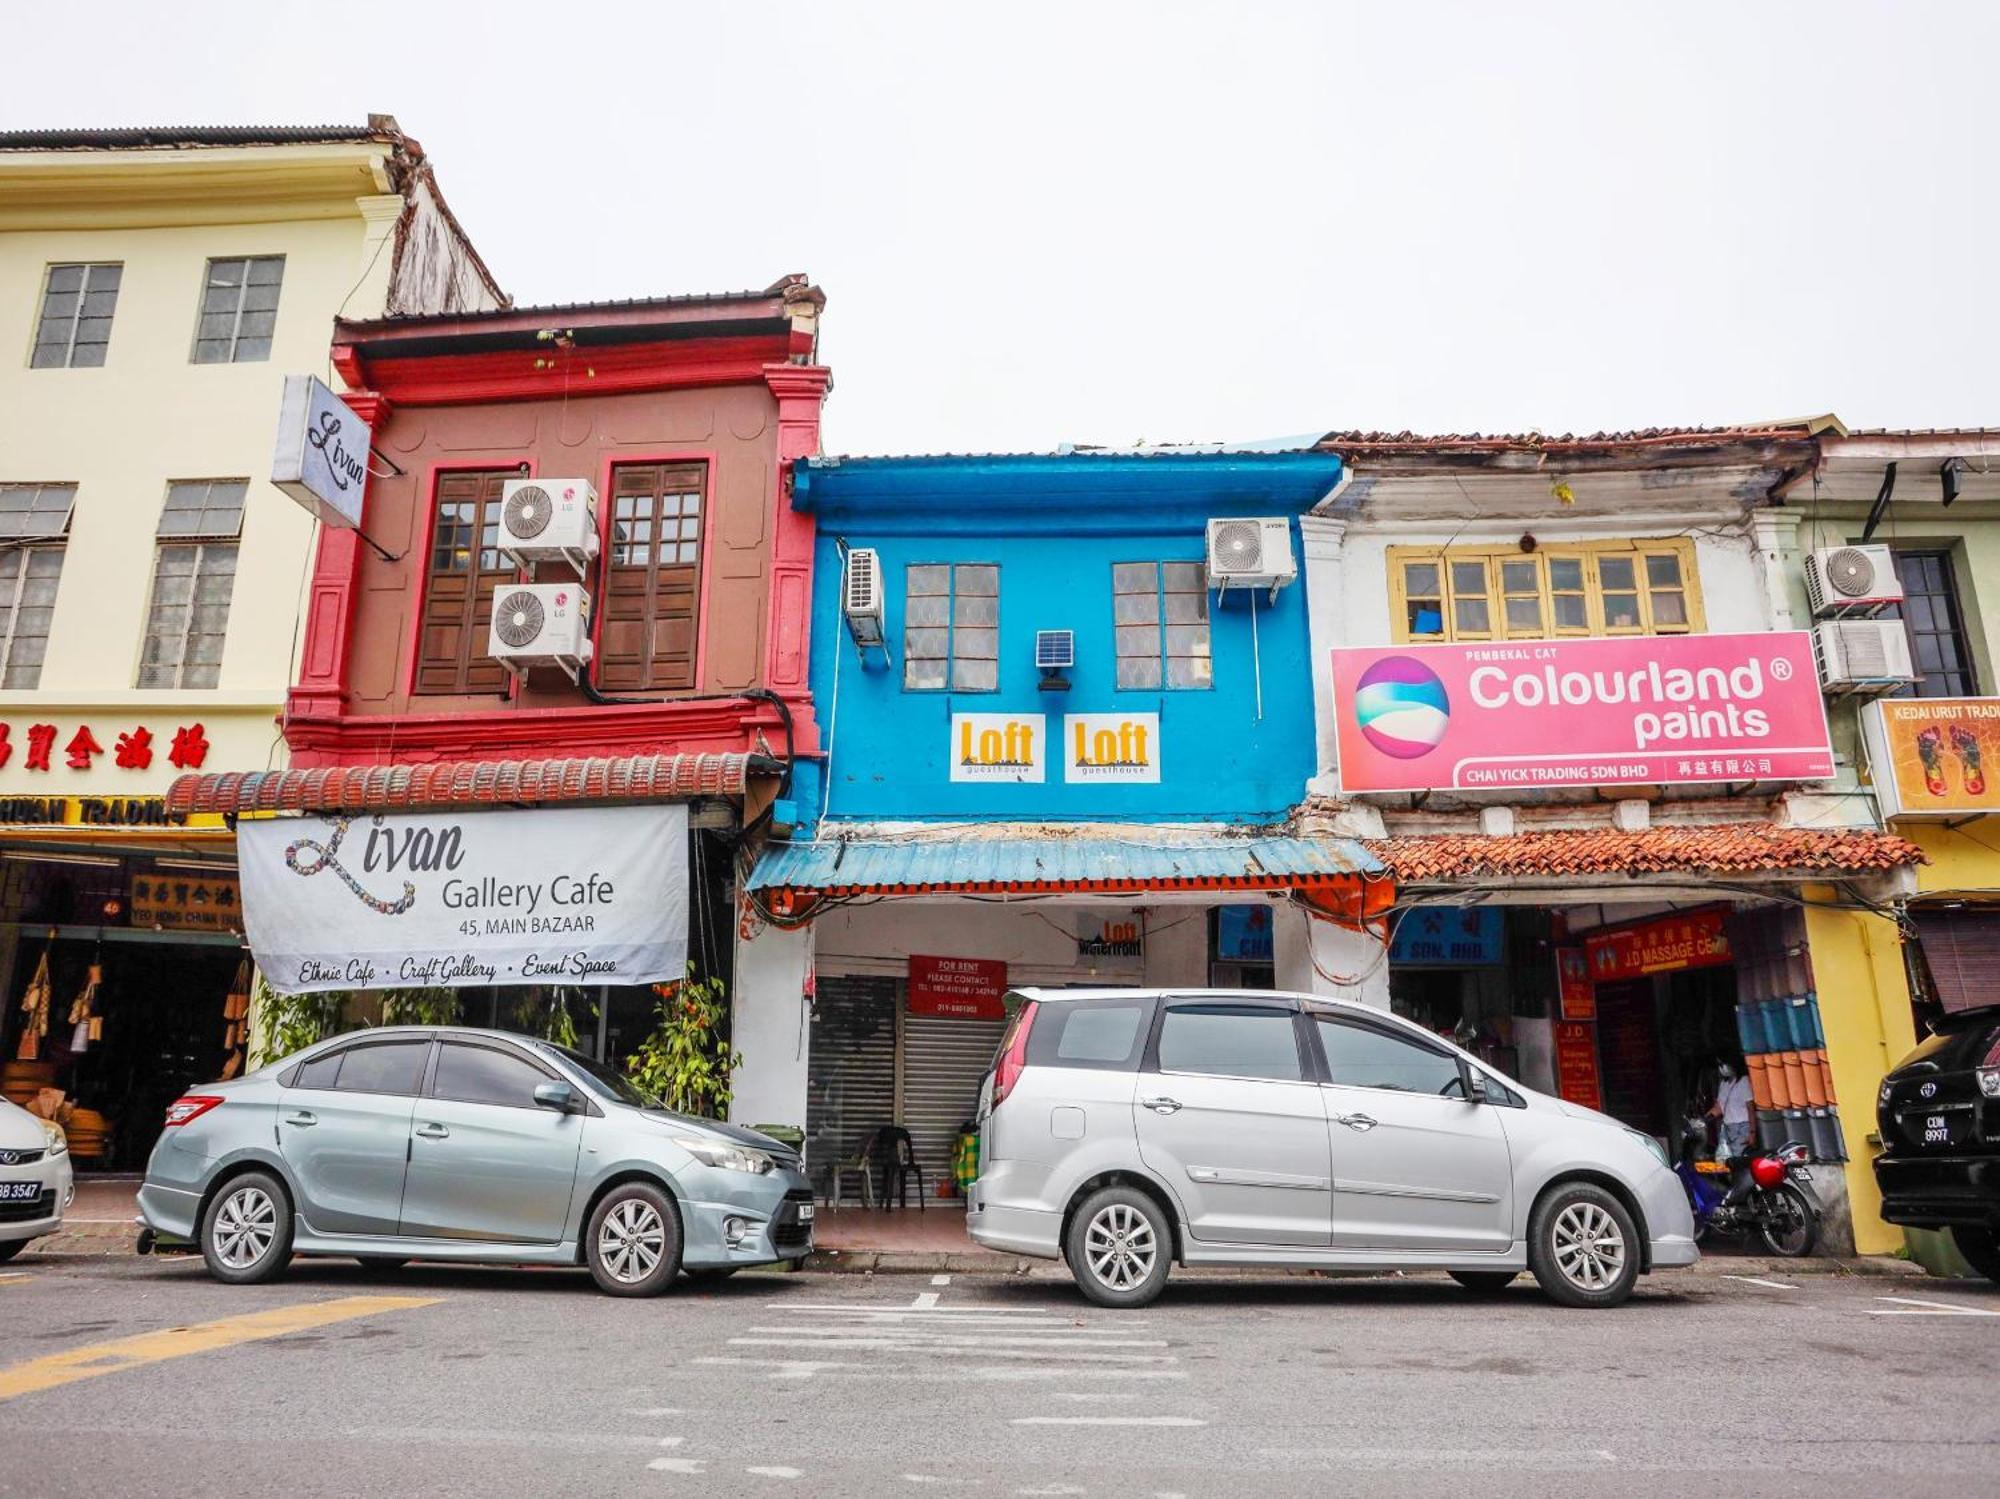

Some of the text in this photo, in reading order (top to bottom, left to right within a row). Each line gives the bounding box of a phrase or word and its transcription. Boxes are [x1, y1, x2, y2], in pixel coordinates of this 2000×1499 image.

[308, 411, 364, 490] Livan
[1465, 648, 1557, 662] PEMBEKAL CAT
[1469, 657, 1764, 709] Colourland
[1894, 706, 1930, 719] KEDAI
[1931, 706, 1962, 719] URUT
[1634, 704, 1770, 749] paints
[961, 722, 1033, 765] Loft
[1075, 722, 1147, 765] Loft
[1082, 766, 1145, 775] guesthouse
[1467, 765, 1648, 783] CHAI YICK TRADING SDN BHD
[442, 873, 613, 915] Gallery Cafe
[459, 916, 594, 936] 45, MAIN BAZAAR
[1642, 941, 1695, 965] MASSAGE
[299, 952, 616, 987] Ethnic Cafe Craft Gallery Event Space
[939, 961, 979, 972] FOR RENT
[1925, 1129, 1948, 1142] 8997
[11, 1183, 38, 1198] 3547
